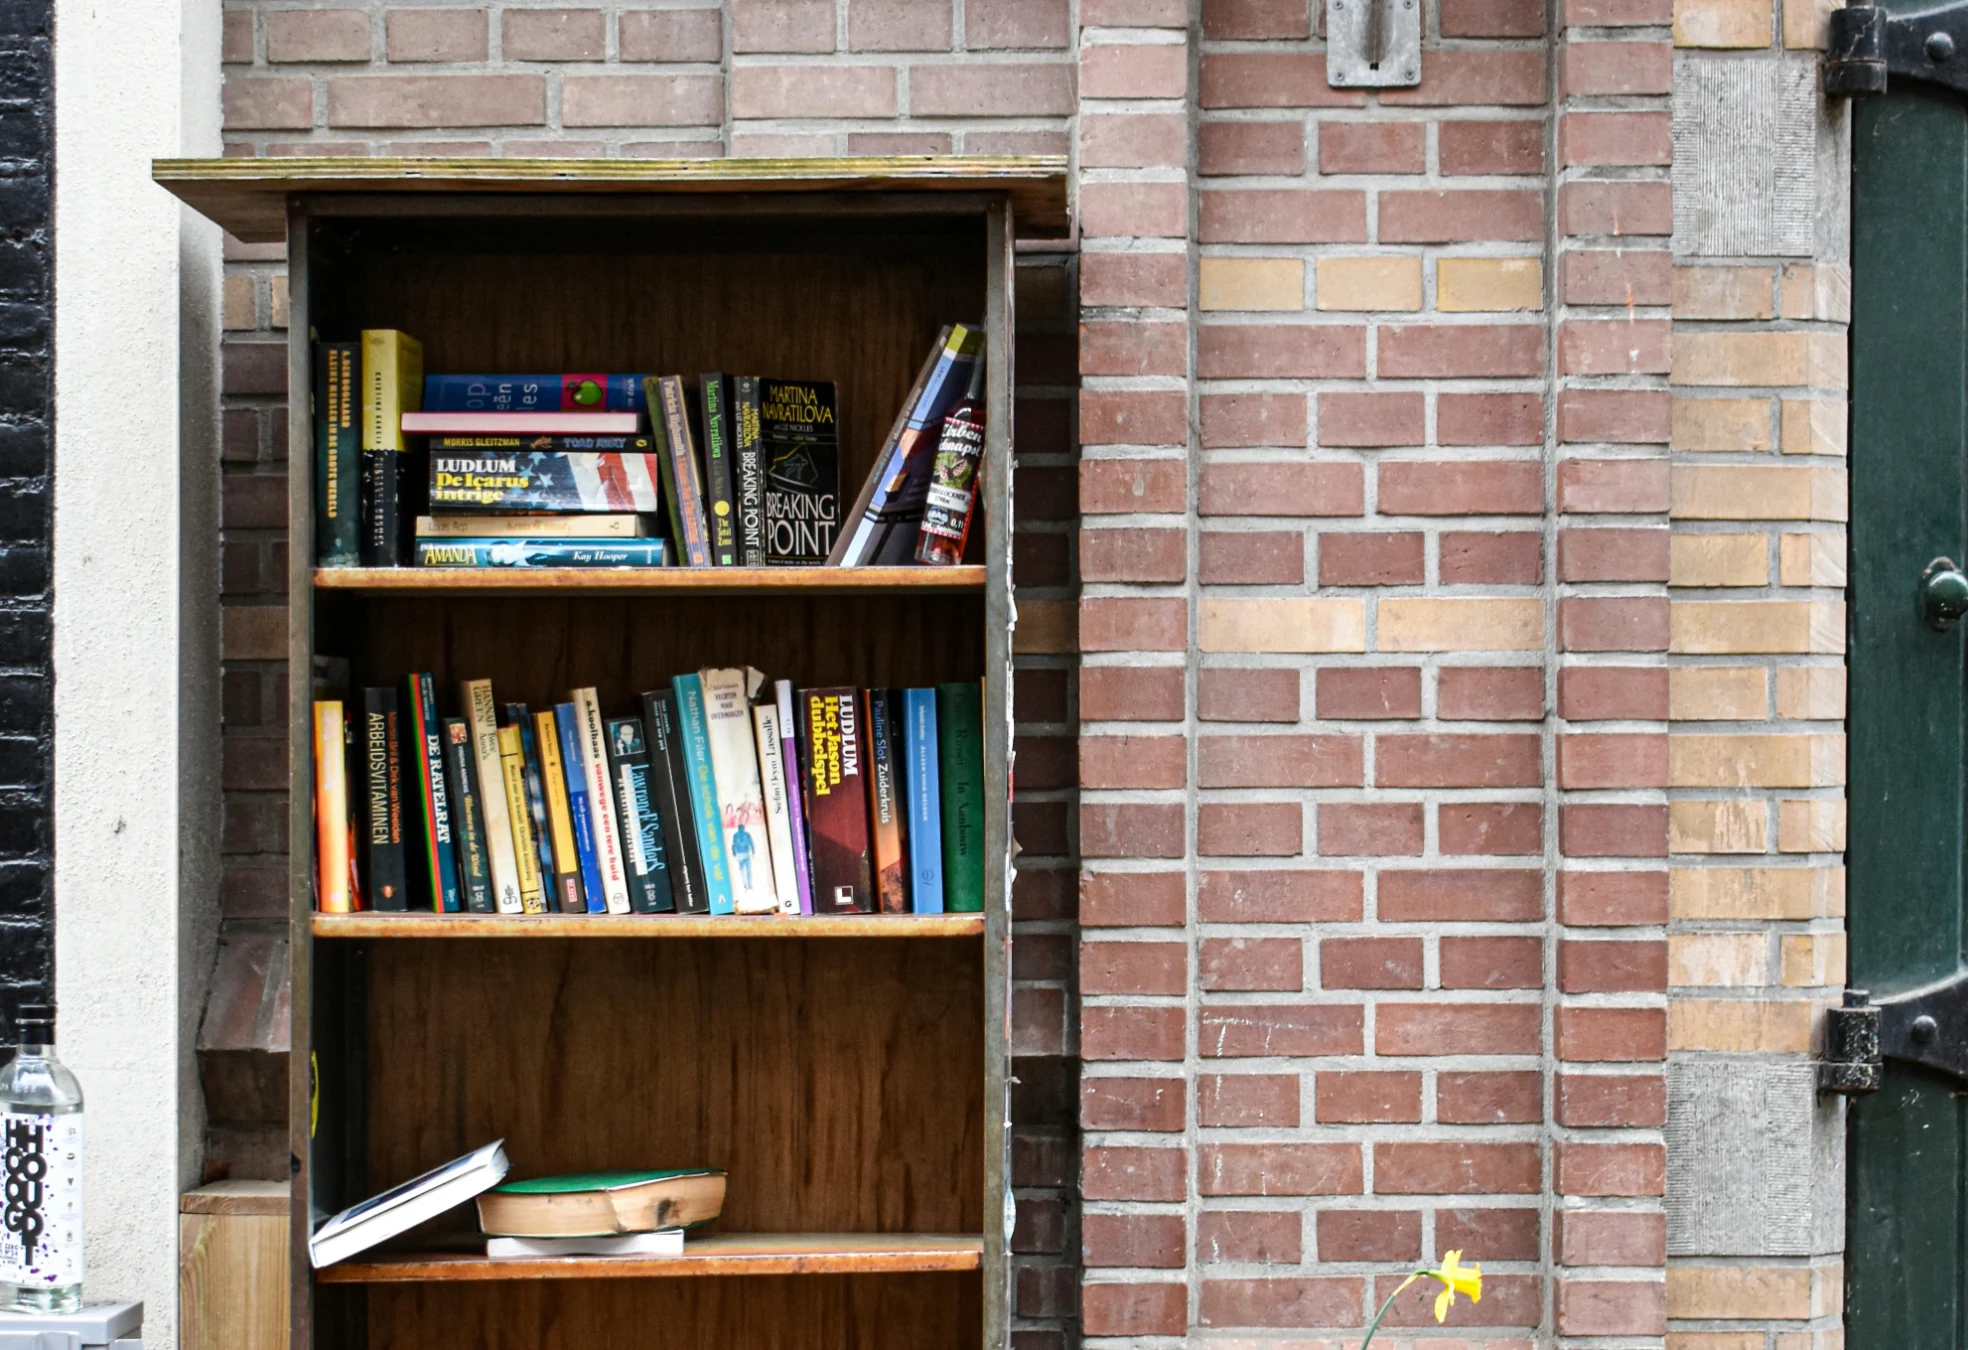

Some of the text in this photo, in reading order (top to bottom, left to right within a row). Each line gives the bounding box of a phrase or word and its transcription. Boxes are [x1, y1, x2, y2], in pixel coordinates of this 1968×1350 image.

[374, 371, 382, 411] CRISTINA
[706, 380, 719, 413] Martina
[769, 384, 818, 405] MARTINA
[663, 381, 687, 456] Patricia Highsmith
[742, 402, 753, 447] NAVRATILOVA
[751, 408, 760, 440] MARTINA
[762, 401, 834, 423] NAVRATILOVA
[328, 424, 338, 434] IN
[328, 436, 338, 447] DE
[443, 437, 520, 447] MORRIS GLEITZMAN
[709, 414, 723, 458] Navratilova
[789, 424, 814, 432] NICKLES
[563, 437, 626, 449] TOAD AWAY
[328, 449, 338, 478] GROTE
[436, 458, 516, 473] LUDLUM
[436, 473, 529, 489] De Icarus
[742, 452, 758, 506] BREAKING
[328, 480, 338, 518] WERELD
[435, 487, 504, 504] intrige
[766, 491, 835, 520] BREAKING
[744, 509, 760, 547] POINT
[767, 519, 835, 556] POINT
[424, 543, 477, 565] AMANDA
[572, 550, 628, 563] Kay Hooper
[472, 686, 485, 723] GREEN
[481, 685, 496, 727] HANNAH
[715, 692, 737, 701] VECHTEN
[387, 711, 398, 741] Martin
[711, 710, 744, 720] OVERMORGEN
[388, 741, 398, 757] Bril
[478, 733, 489, 760] Anna's
[487, 732, 498, 753] Twee
[761, 715, 776, 756] Lassalle
[809, 695, 830, 796] dubbelspel
[824, 695, 841, 786] Het Jason
[839, 694, 859, 776] LUDLUM
[457, 745, 470, 793] VIRGINIA ANDREWS
[873, 700, 891, 824] Pauline Slot Zuiderkruis
[920, 745, 928, 771] ALLEEN
[368, 712, 389, 844] ARBEIDSVITAMINEN
[390, 765, 399, 784] Dirk
[617, 778, 625, 789] DE
[687, 691, 723, 881] Nathan Filer De schok van de val
[956, 781, 970, 794] In
[391, 784, 399, 802] van
[427, 735, 450, 844] DE RATELRAT
[585, 700, 620, 882] a.koolhaas vanwege een tere huid
[619, 790, 630, 816] EERSTE
[630, 764, 658, 821] LawrencE
[773, 788, 783, 815] Stefan
[464, 795, 475, 831] Bloemen
[921, 793, 929, 821] HELDEN
[391, 802, 401, 843] Weelden
[468, 842, 477, 852] de
[470, 854, 482, 876] Wind
